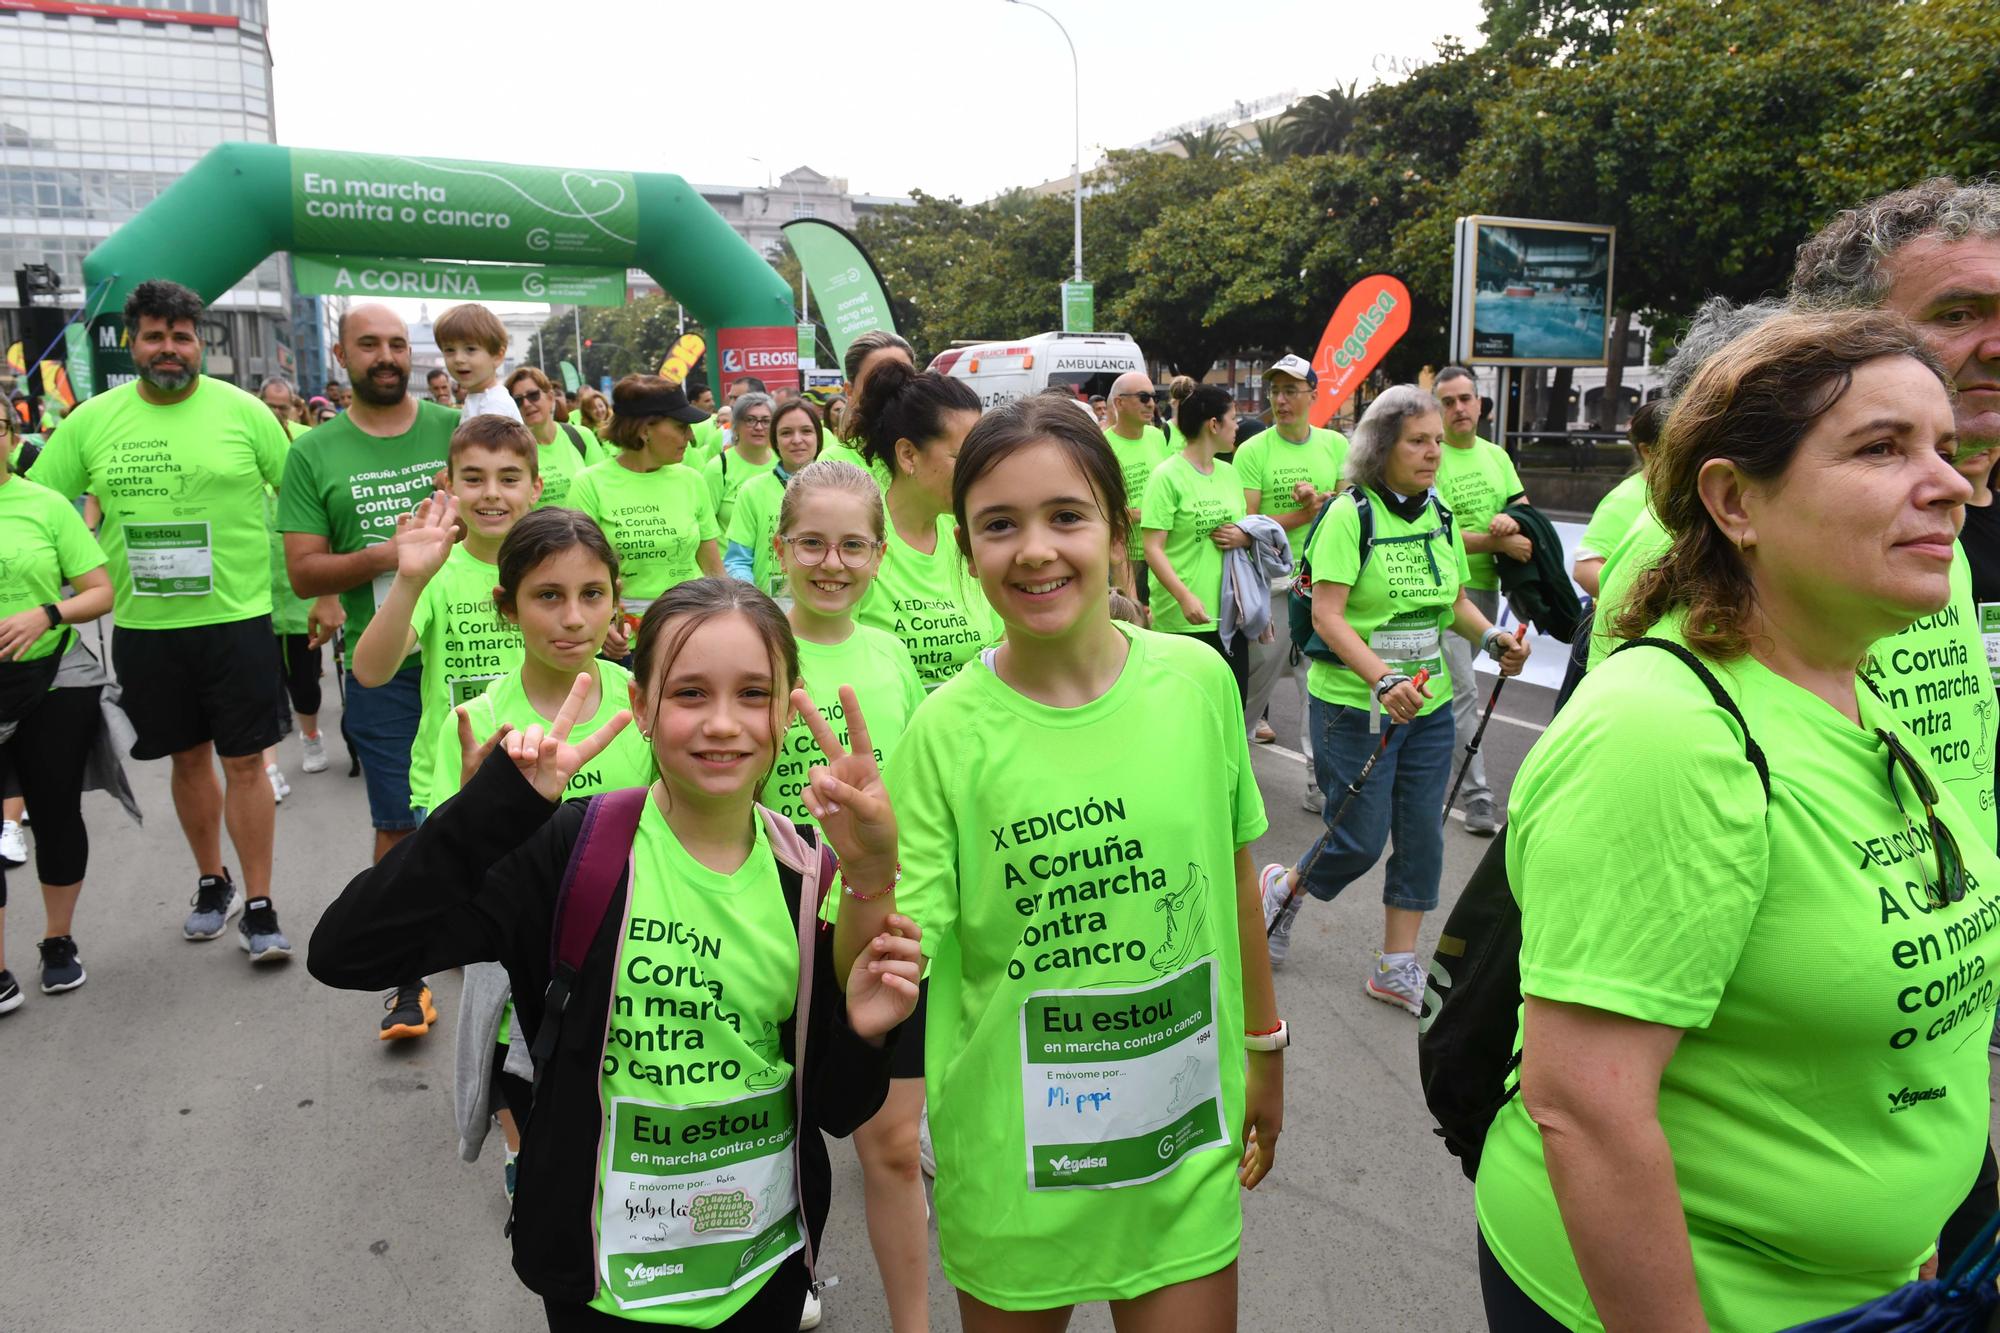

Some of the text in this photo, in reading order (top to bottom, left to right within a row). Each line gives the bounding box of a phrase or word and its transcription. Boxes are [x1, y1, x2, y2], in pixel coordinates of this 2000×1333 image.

[304, 173, 446, 203] En marcha
[306, 199, 511, 229] contra o cancro
[335, 268, 480, 296] A CORUÑA
[1316, 289, 1398, 383] Vegalsa
[1056, 359, 1136, 370] AMBULANCIA
[122, 439, 168, 450] EDICIÓN
[121, 452, 172, 463] Coruña
[106, 463, 182, 475] en marcha
[356, 469, 398, 481] CORUÑA
[411, 460, 447, 473] EDICIÓN
[106, 475, 152, 487] contra
[351, 473, 433, 499] En march
[120, 487, 169, 497] cancro
[355, 496, 412, 514] contra
[620, 505, 660, 516] EDICIÓN
[360, 519, 370, 530] o
[625, 516, 667, 527] Coruña
[145, 528, 181, 539] estou
[614, 526, 677, 538] en marcha
[615, 539, 655, 550] contra
[627, 550, 667, 560] cancro
[1386, 552, 1394, 562] A
[1388, 566, 1402, 574] en
[1389, 576, 1424, 586] contra
[1389, 588, 1439, 598] o cancro
[445, 601, 498, 614] X EDICI
[892, 600, 902, 612] X
[445, 622, 454, 635] A
[894, 613, 968, 632] A Coruña
[445, 638, 525, 651] en march
[923, 629, 981, 647] marcha
[444, 654, 501, 668] contra
[911, 650, 952, 665] ontra
[1891, 639, 1968, 675] Coruña
[1884, 670, 1980, 709] n marcha
[777, 761, 803, 777] en
[781, 804, 793, 817] o
[991, 797, 1126, 851] X EDICIÓN
[1004, 835, 1143, 889] A Coruña
[1852, 841, 1880, 870] X
[1048, 865, 1167, 910] marcha
[1878, 886, 1910, 924] A
[1019, 911, 1107, 947] ontra
[1007, 940, 1146, 980] o cancro
[1892, 933, 1942, 969] en
[1897, 954, 1985, 1014] contra
[615, 995, 741, 1034] n marca
[1043, 998, 1173, 1032] Eu estou
[1889, 979, 1993, 1050] o cancro
[1043, 1010, 1202, 1053] en marcha contra o cancro
[1197, 1030, 1211, 1045] 1994
[603, 1055, 741, 1086] o cancro
[1047, 1071, 1053, 1080] E
[1055, 1069, 1100, 1080] móvome
[1048, 1086, 1069, 1107] Mi
[1888, 1085, 1947, 1107] Vegalsa
[633, 1110, 769, 1146] Eu estou
[630, 1151, 648, 1164] en
[652, 1152, 707, 1166] marcha
[710, 1141, 753, 1159] contra
[756, 1137, 766, 1147] o
[1049, 1154, 1107, 1173] Vegalsa
[629, 1181, 636, 1191] E
[638, 1181, 685, 1191] móvome
[624, 1262, 684, 1282] Vegalsa
